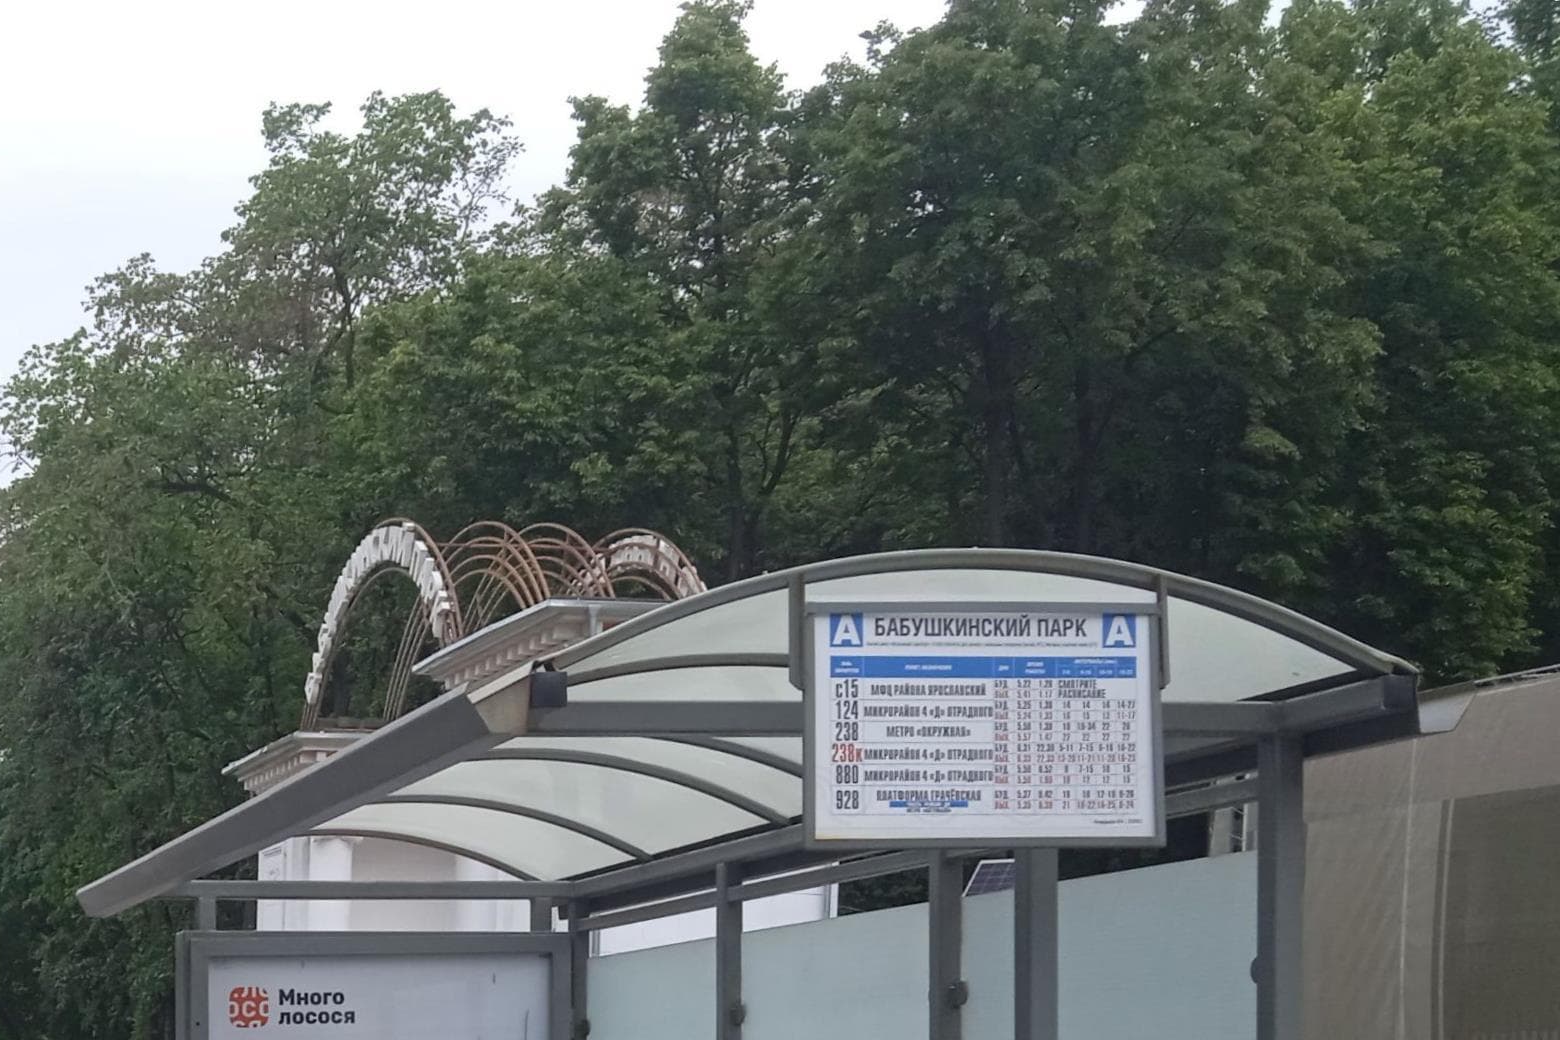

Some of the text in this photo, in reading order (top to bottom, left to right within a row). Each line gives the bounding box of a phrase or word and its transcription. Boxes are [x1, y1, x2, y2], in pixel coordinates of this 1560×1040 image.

[875, 614, 1030, 636] БАБУШКИНСКИЙ
[1037, 618, 1087, 637] ПАРК
[836, 700, 859, 720] 124
[836, 722, 859, 741] 238
[836, 765, 859, 784] 880
[836, 790, 859, 809] 928
[278, 988, 345, 1006] Много
[278, 1011, 355, 1025] лосося
